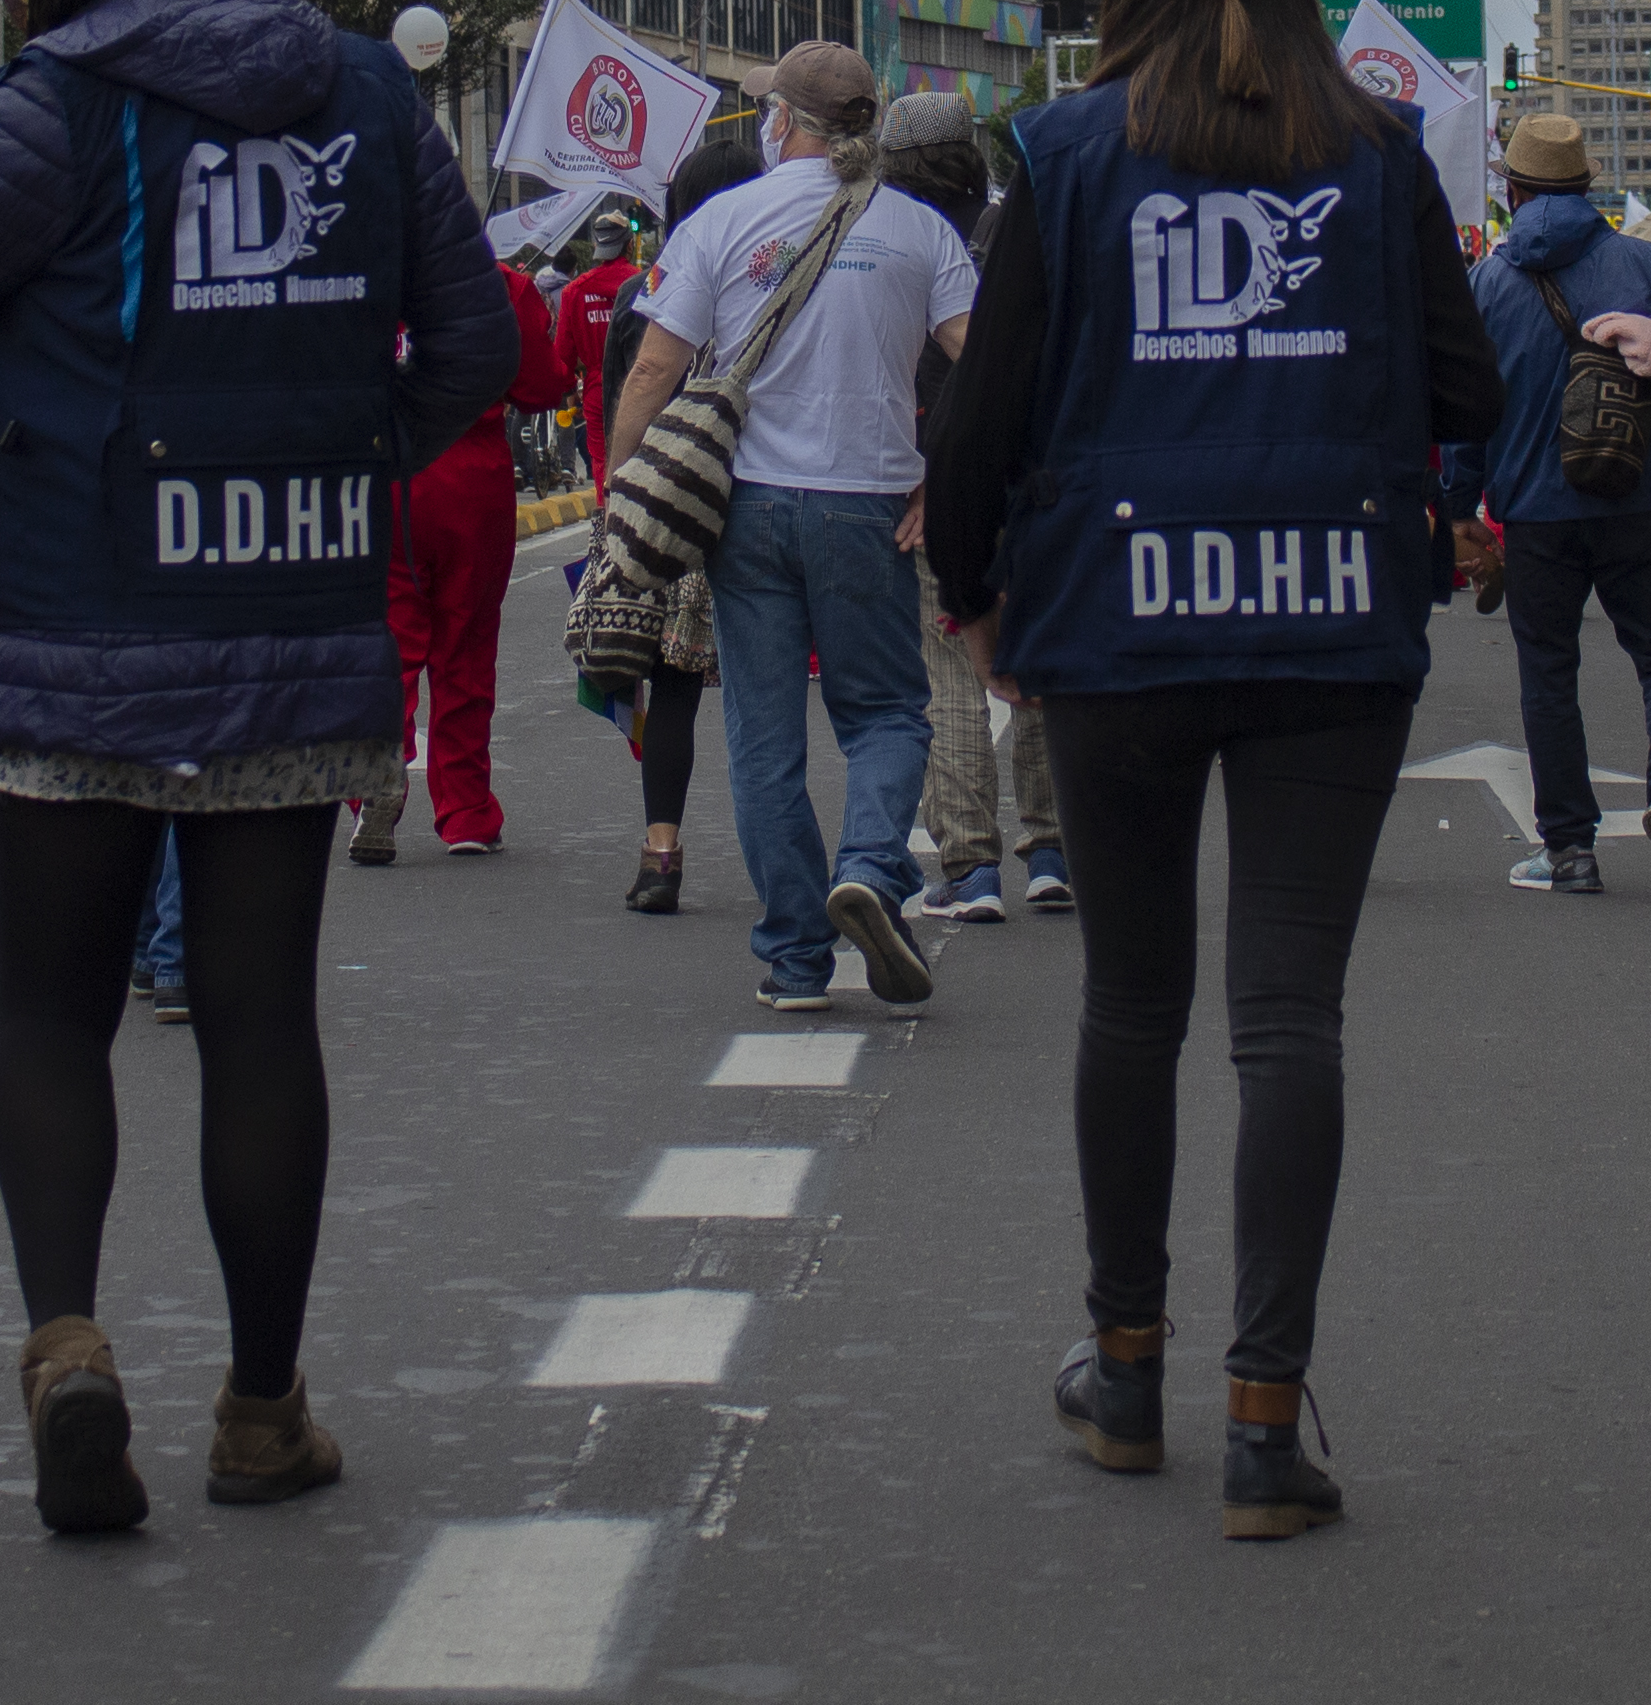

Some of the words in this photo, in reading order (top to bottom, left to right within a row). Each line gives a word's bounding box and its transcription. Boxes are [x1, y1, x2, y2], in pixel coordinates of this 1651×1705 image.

[592, 58, 643, 107] BOGOTA
[1367, 50, 1416, 91] BOGOTA
[544, 148, 606, 173] TRABAJADORES
[557, 151, 596, 164] CENTRAL
[173, 278, 278, 311] Derechos
[285, 275, 367, 304] Humanos
[1133, 330, 1237, 361] Derechos
[1247, 328, 1347, 359] Humanos
[157, 474, 372, 564] D.D.H.H
[1130, 529, 1371, 617] D.D.H.H
